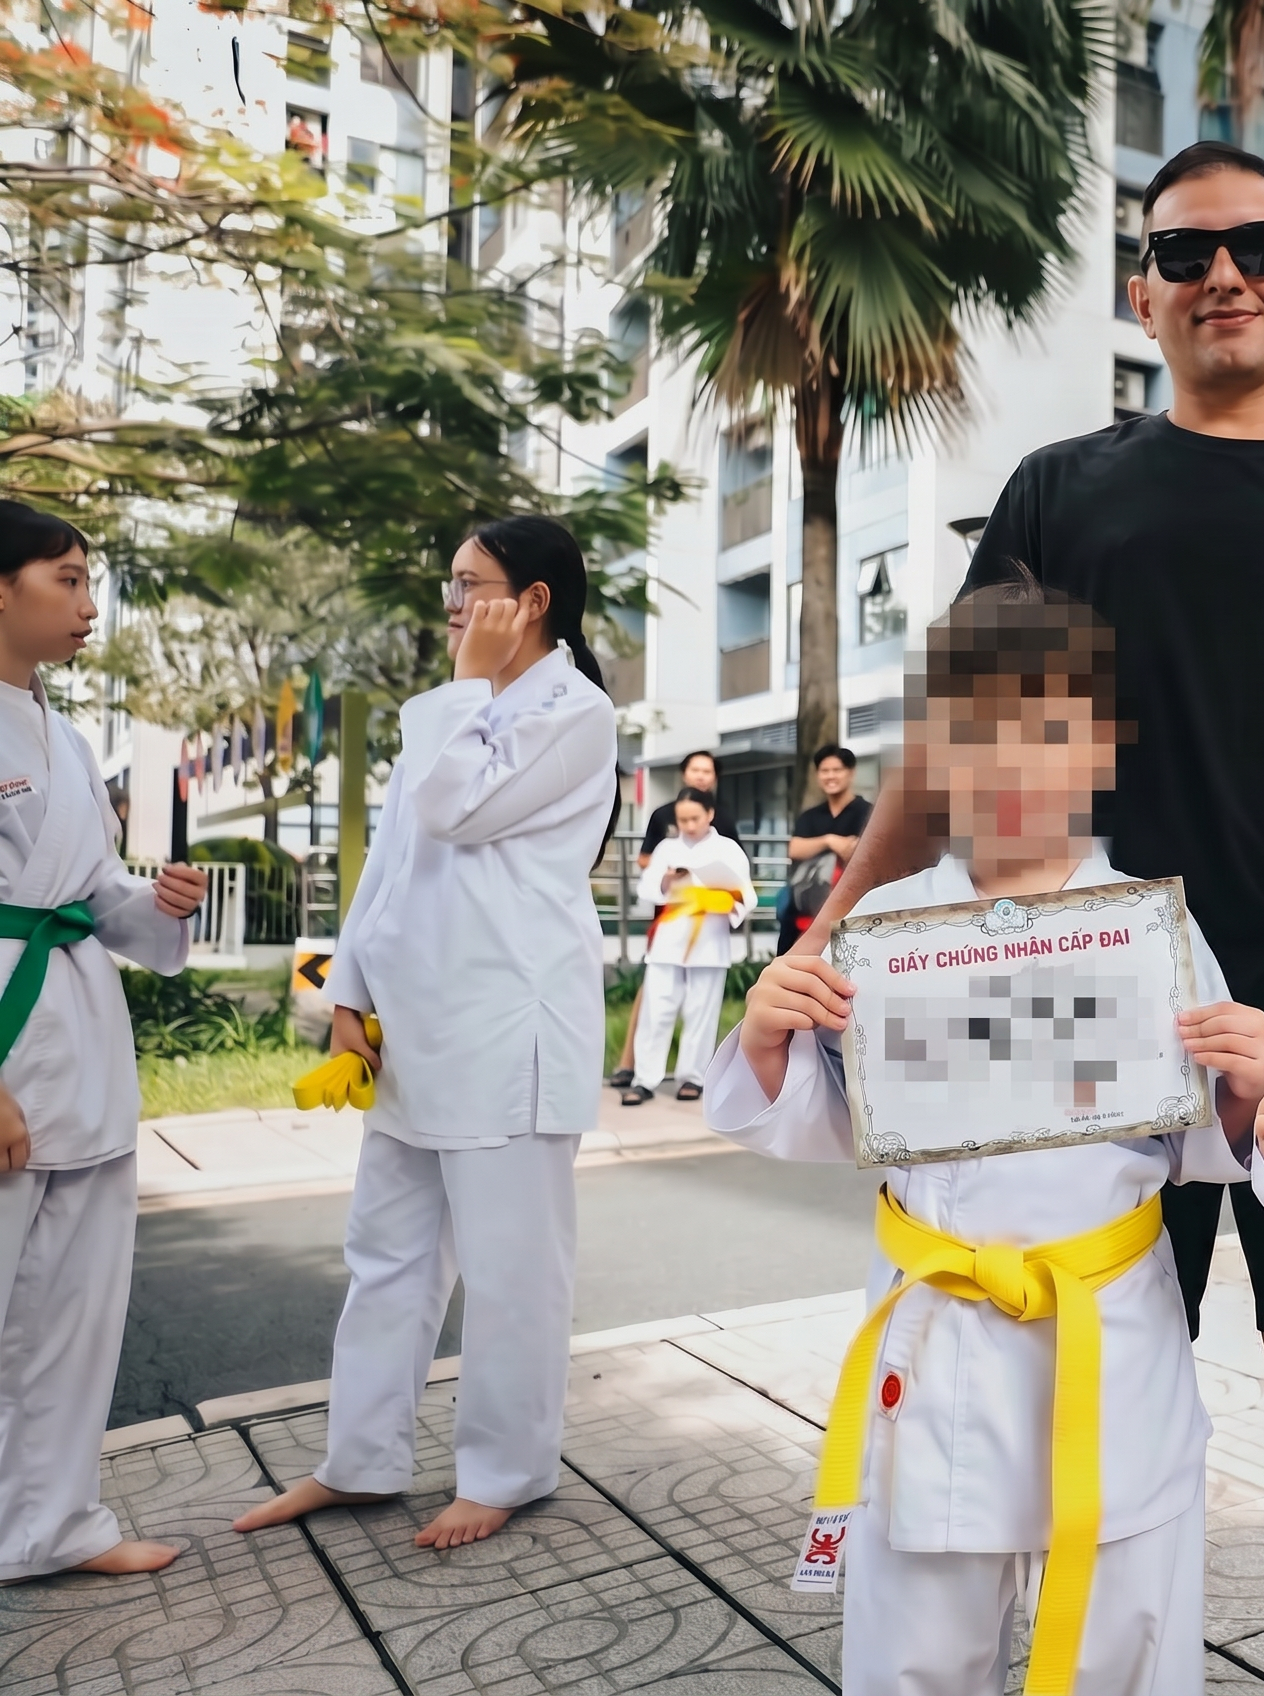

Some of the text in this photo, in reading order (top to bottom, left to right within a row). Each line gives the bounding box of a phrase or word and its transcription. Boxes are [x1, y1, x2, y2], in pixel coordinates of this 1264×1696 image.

[888, 927, 1130, 974] GIẤY CHỨNG NHẬN CẤP ĐAI
